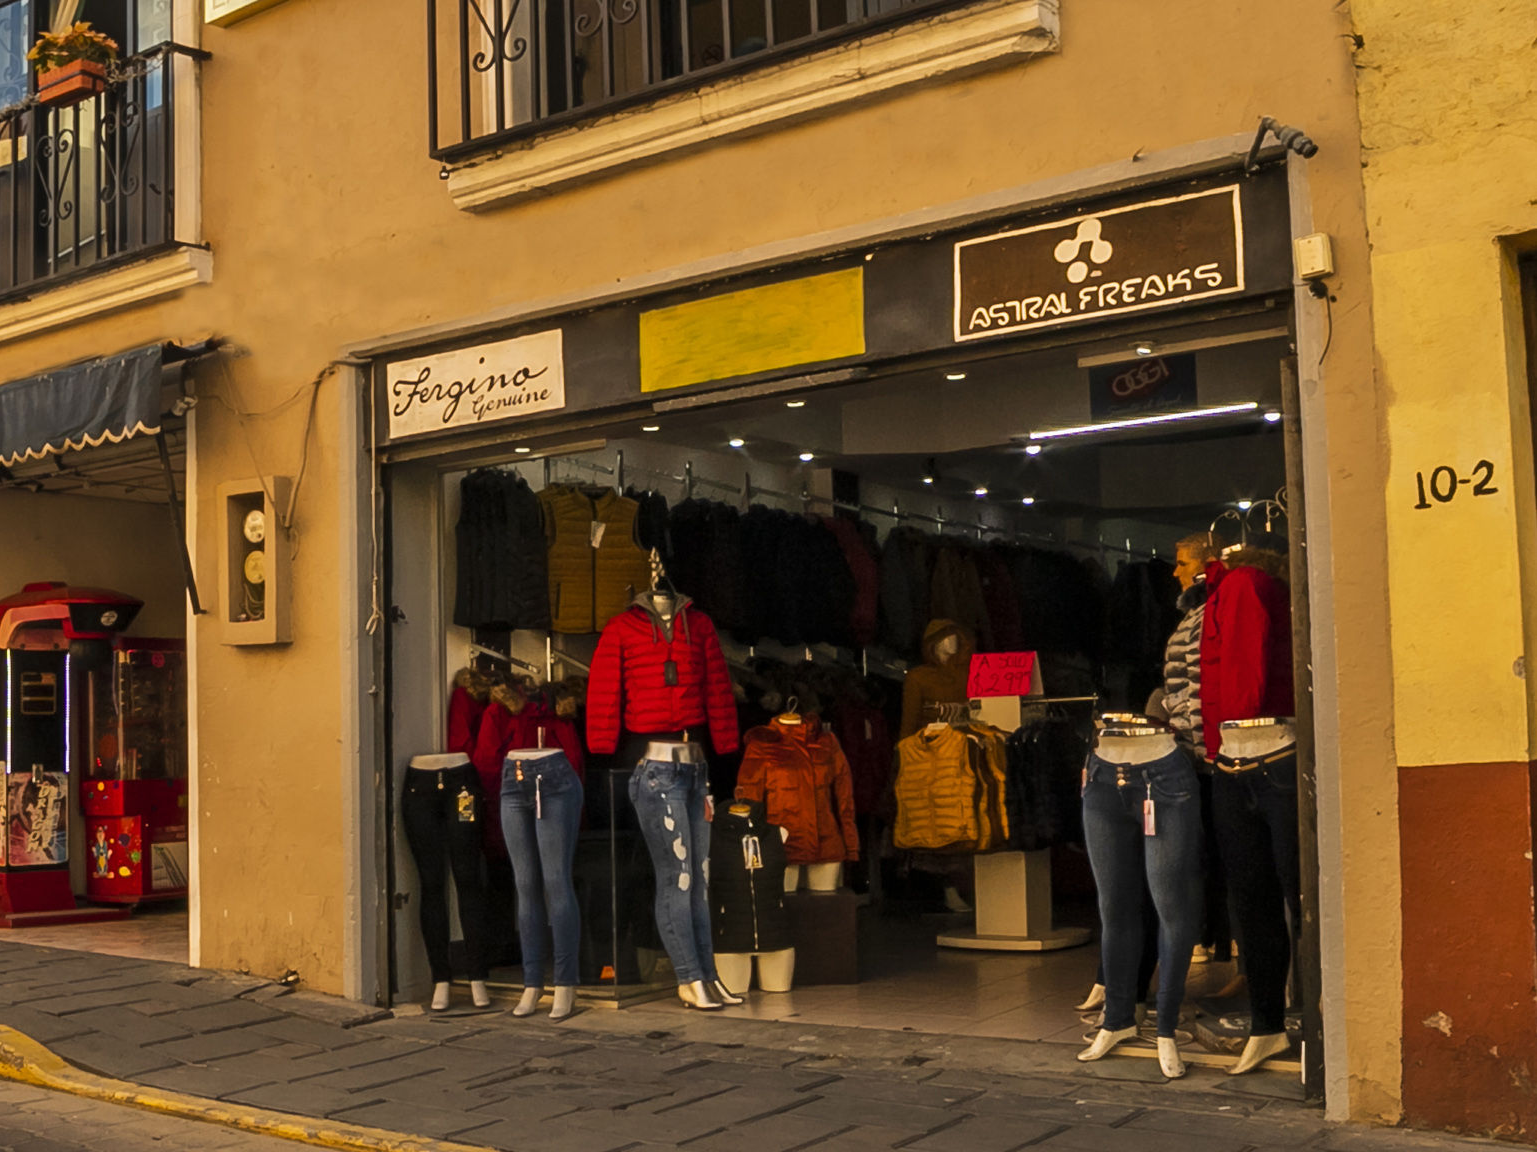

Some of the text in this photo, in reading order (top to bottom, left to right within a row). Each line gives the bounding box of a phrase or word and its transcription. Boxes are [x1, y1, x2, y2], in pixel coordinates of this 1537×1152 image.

[968, 262, 1223, 330] ASTRAL FREAKS
[392, 356, 549, 424] Fergino
[471, 386, 551, 421] Genuine
[1414, 459, 1499, 509] 10-2
